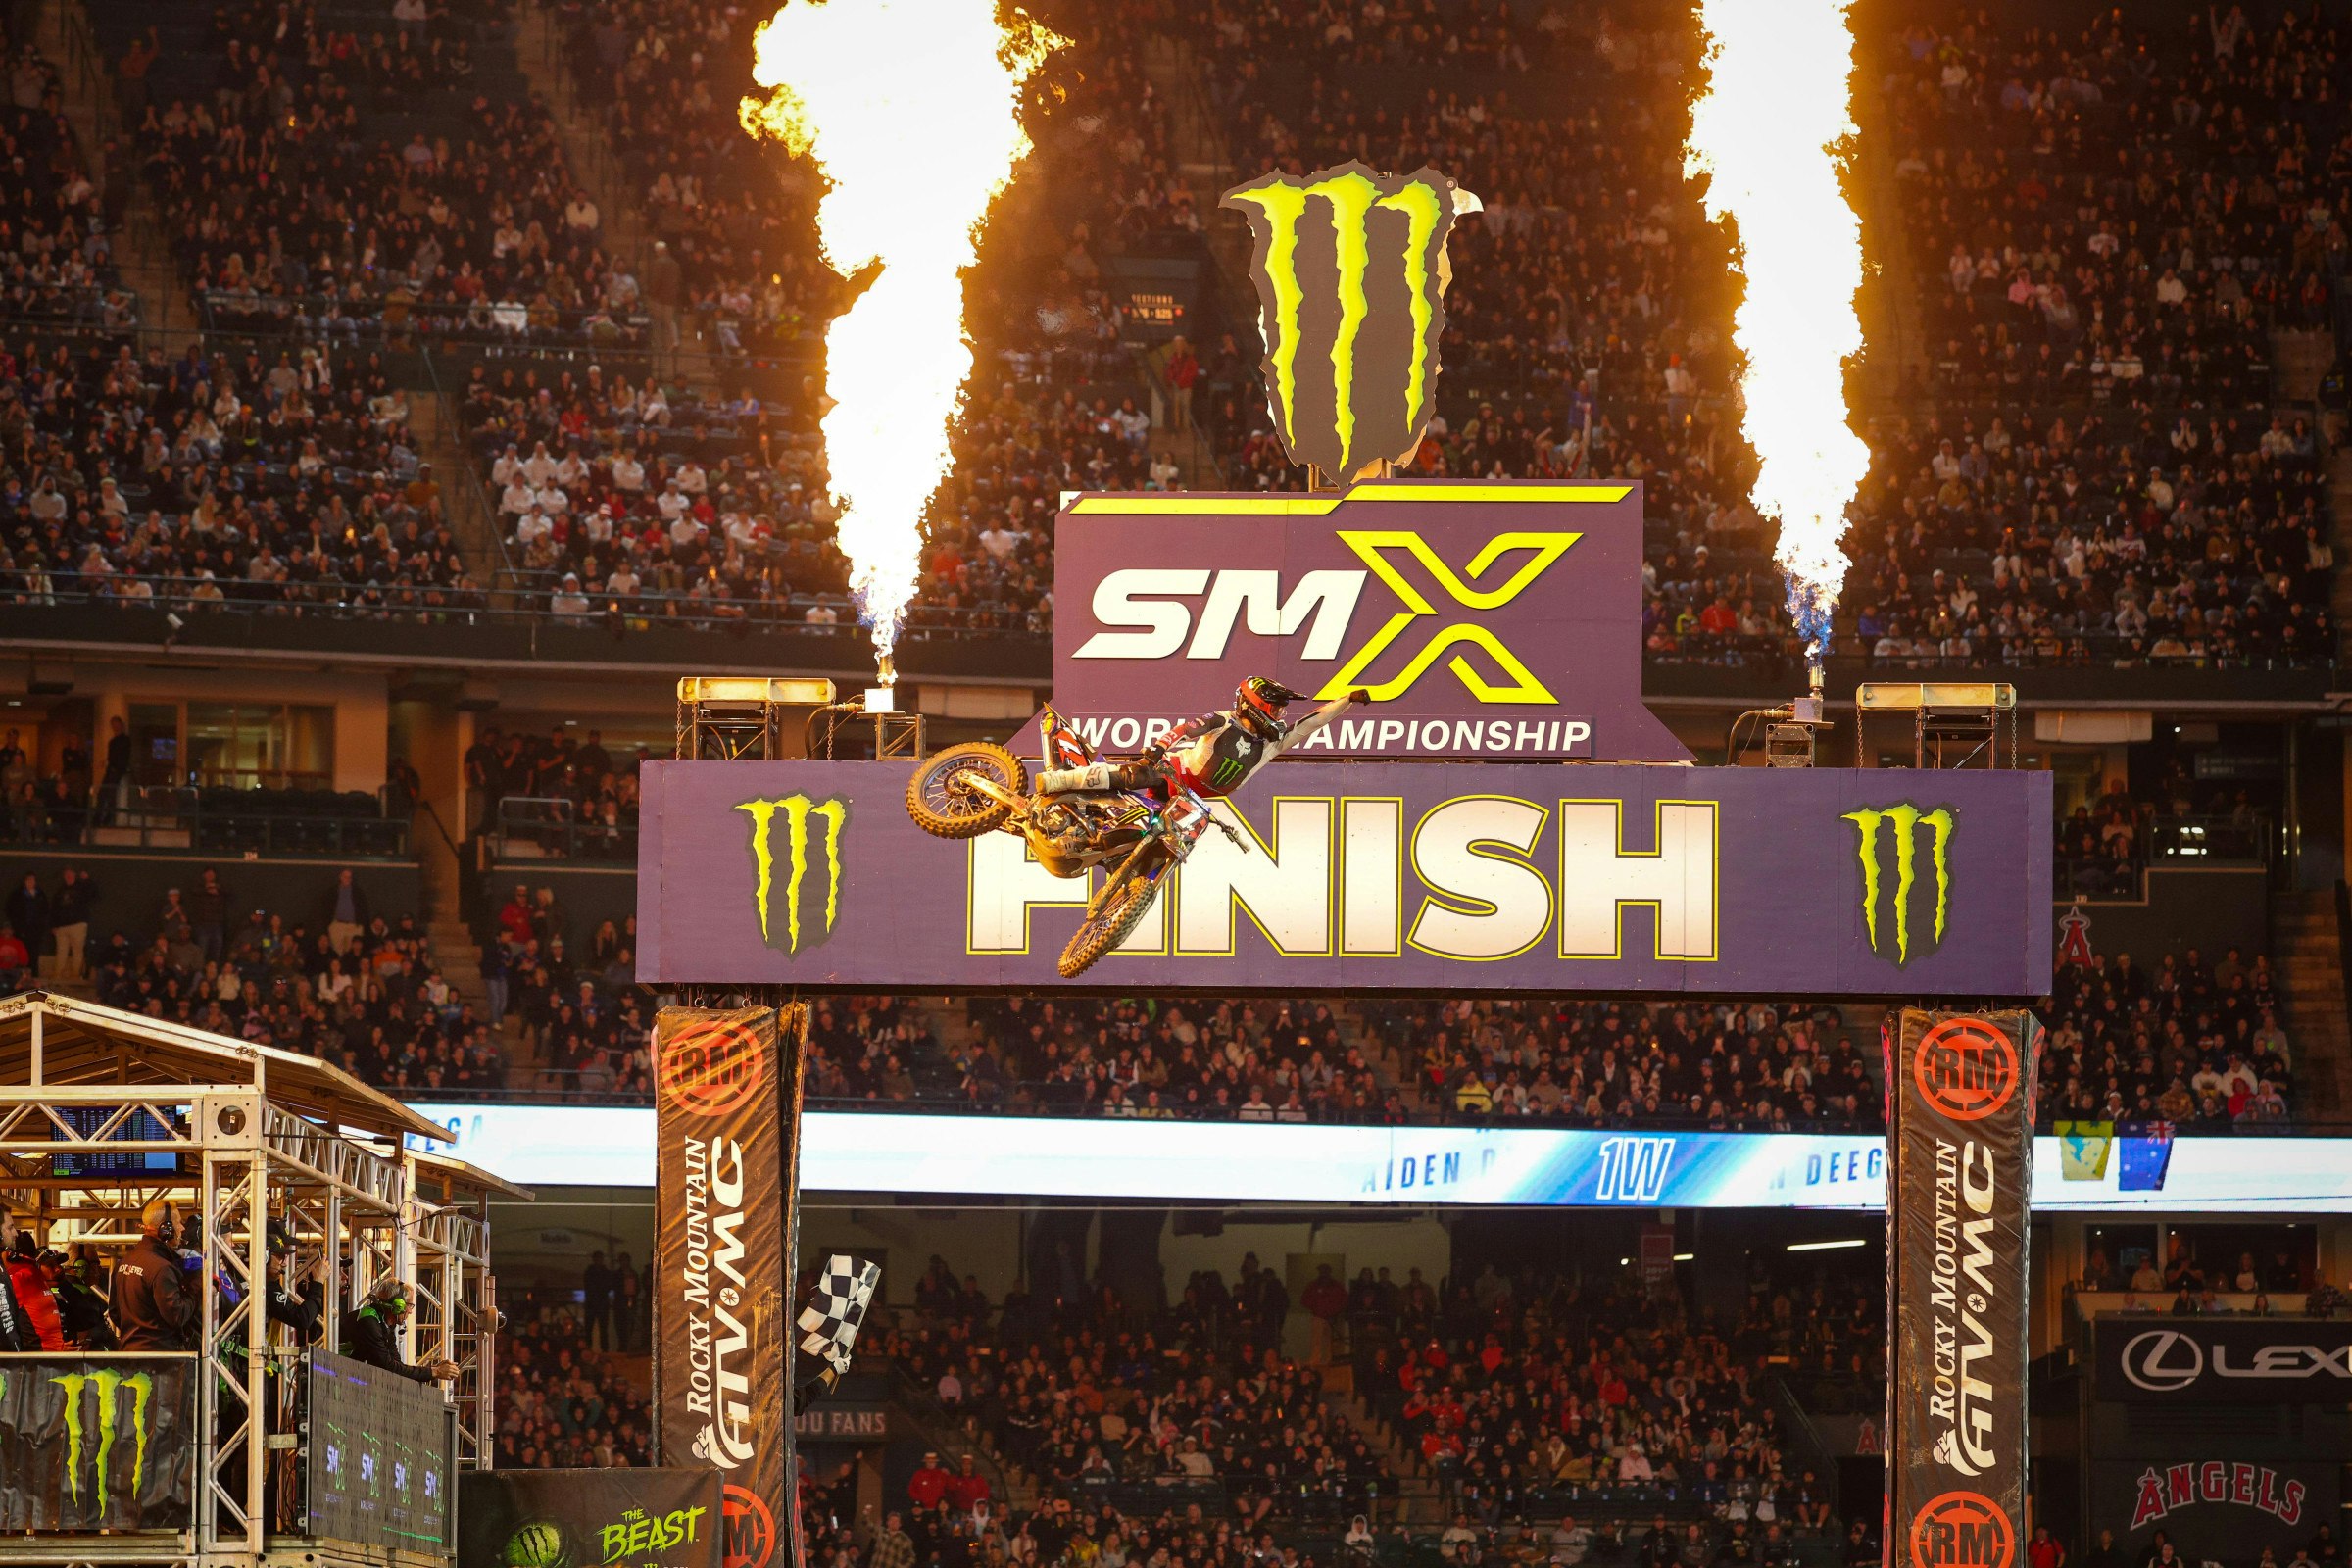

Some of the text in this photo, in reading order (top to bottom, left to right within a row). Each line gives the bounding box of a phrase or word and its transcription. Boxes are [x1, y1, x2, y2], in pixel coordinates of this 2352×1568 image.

[1071, 530, 1584, 704] SMX
[1290, 717, 1592, 751] AMPIONSHIP
[682, 1045, 743, 1087] RM
[1935, 1048, 1998, 1091] RM
[1806, 1148, 1883, 1186] DEEG
[684, 1135, 711, 1417] ROCKY MOUNTAIN
[1931, 1138, 1958, 1424] ROCKY MOUNTAIN
[2212, 1345, 2352, 1378] LEX
[831, 1411, 886, 1435] FANS
[621, 1508, 645, 1522] THE
[2130, 1460, 2306, 1531] ANGELS
[593, 1505, 707, 1566] BEAST
[1932, 1521, 1992, 1565] RM
